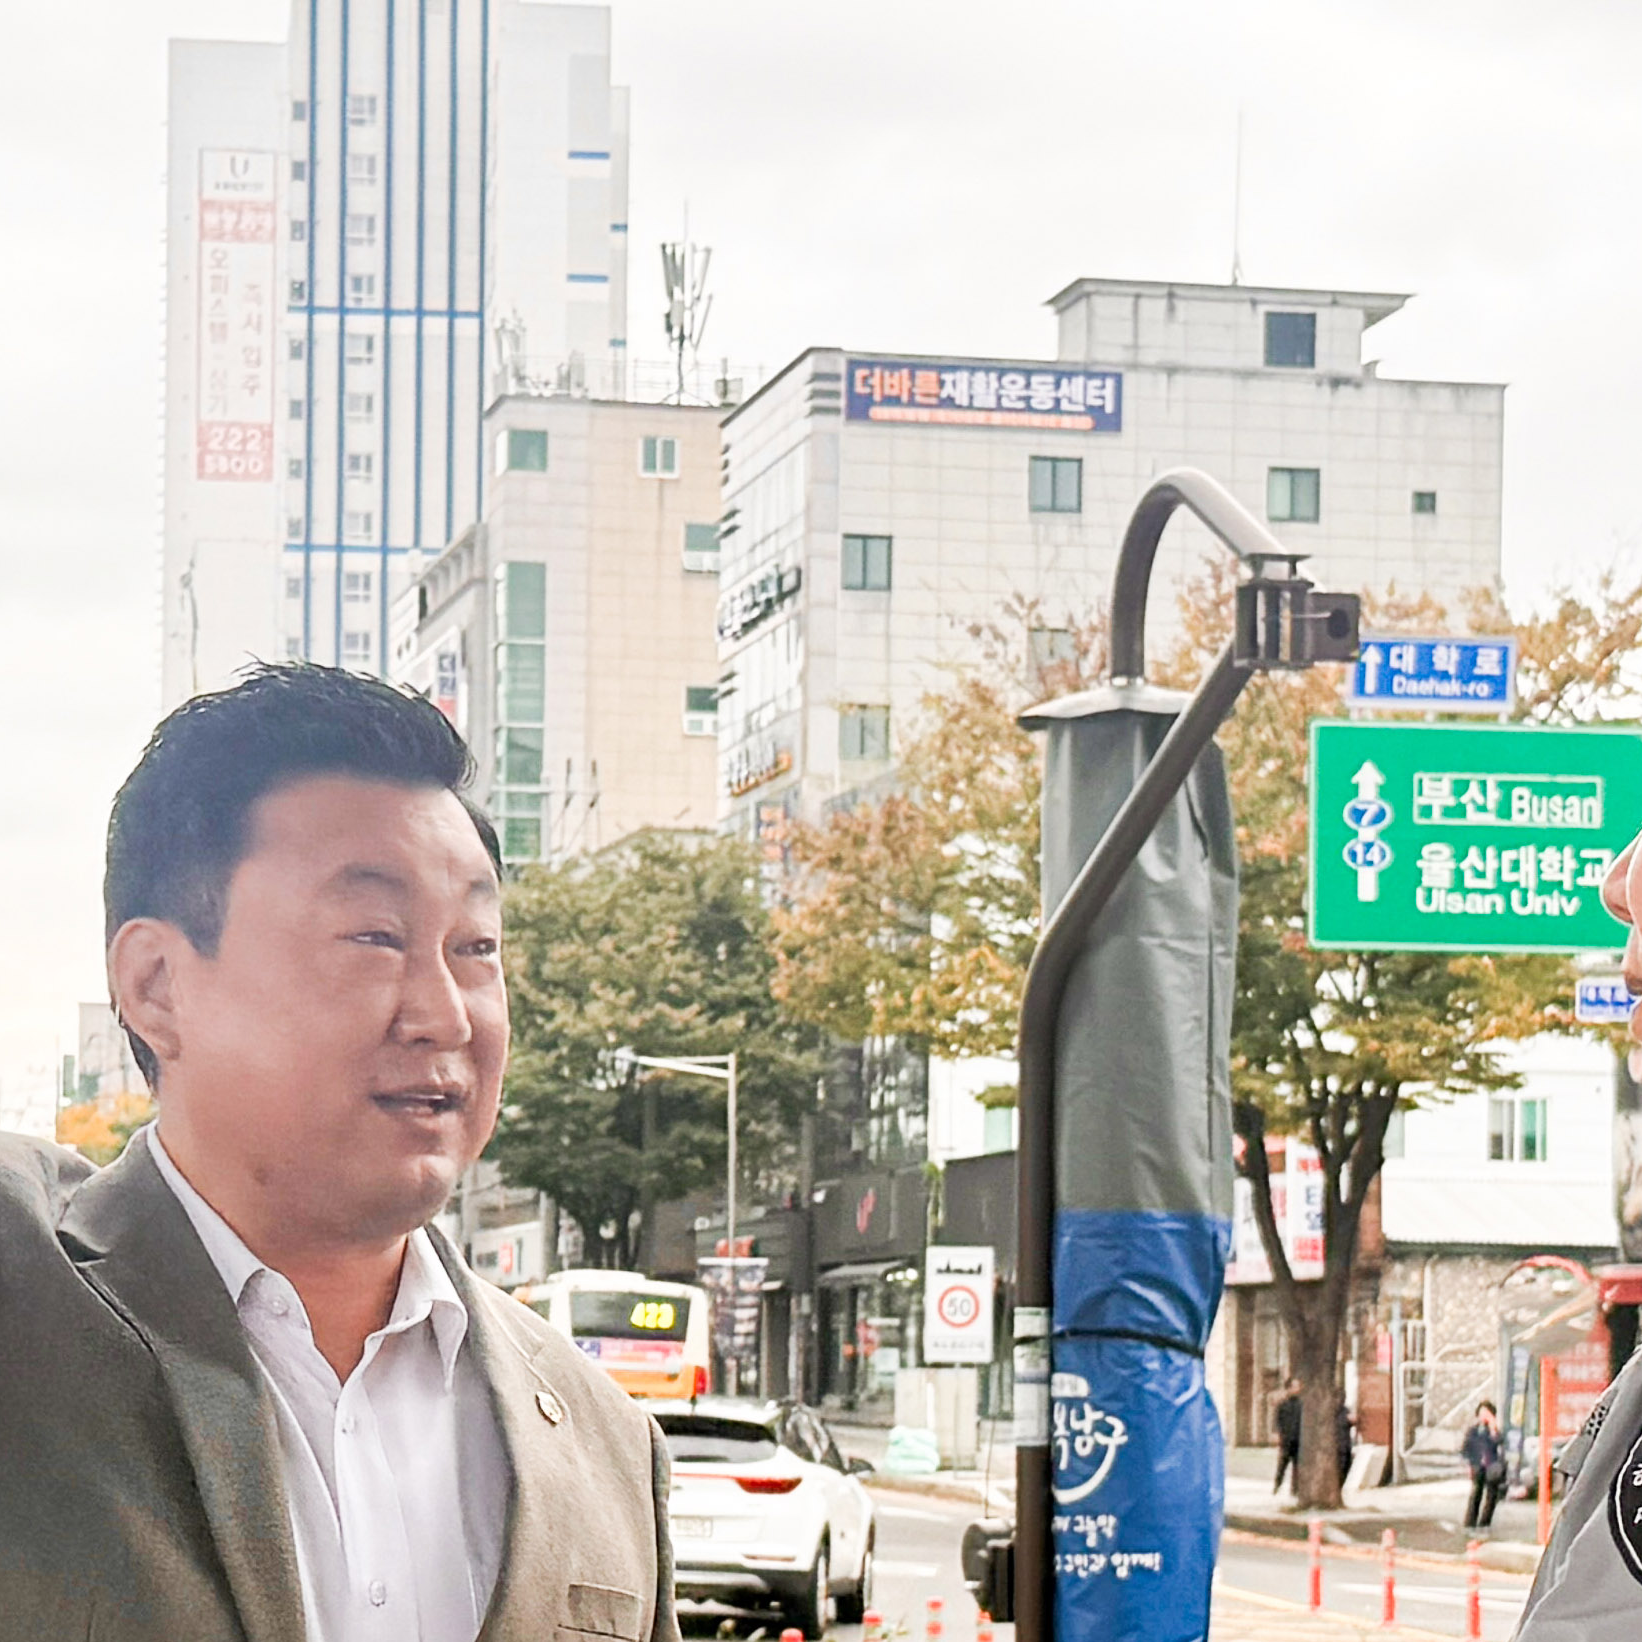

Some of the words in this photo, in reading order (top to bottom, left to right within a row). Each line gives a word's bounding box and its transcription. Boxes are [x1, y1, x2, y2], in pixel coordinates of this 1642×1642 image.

[208, 426, 263, 451] 222
[1392, 674, 1490, 698] Daehak-ro
[1417, 776, 1500, 822] 부산
[1510, 785, 1598, 825] Busan
[1358, 803, 1380, 826] 7
[1357, 843, 1382, 866] 14
[1416, 842, 1615, 891] 울산대학교
[1415, 886, 1506, 914] Ulsan
[1510, 888, 1581, 916] Univ
[947, 1299, 972, 1318] 50
